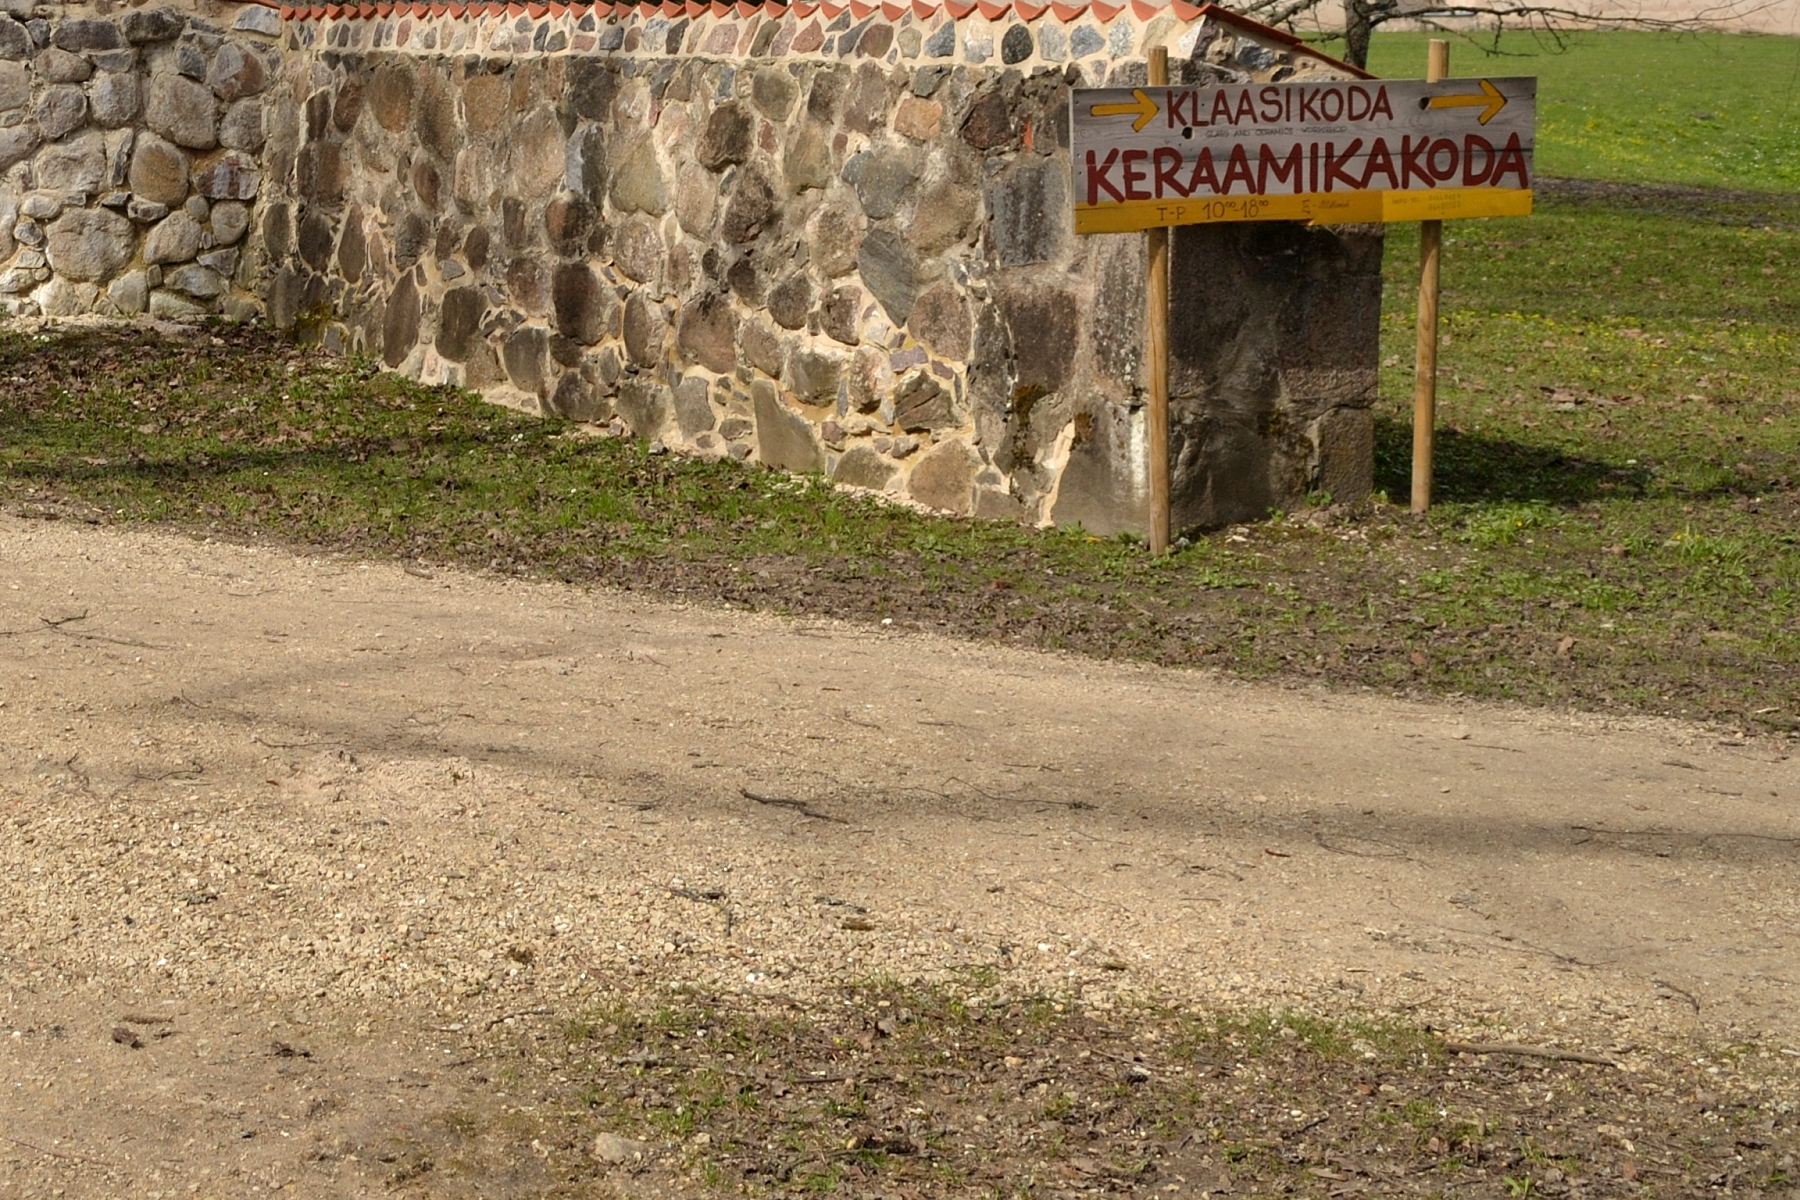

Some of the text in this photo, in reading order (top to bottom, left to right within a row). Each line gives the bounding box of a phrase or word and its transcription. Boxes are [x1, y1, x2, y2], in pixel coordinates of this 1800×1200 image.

[1166, 85, 1394, 129] KLAASIKODA
[1205, 125, 1348, 139] GLASS AND CERAMICS WORKSHOP
[1085, 131, 1529, 207] KERAAMIKAKODA
